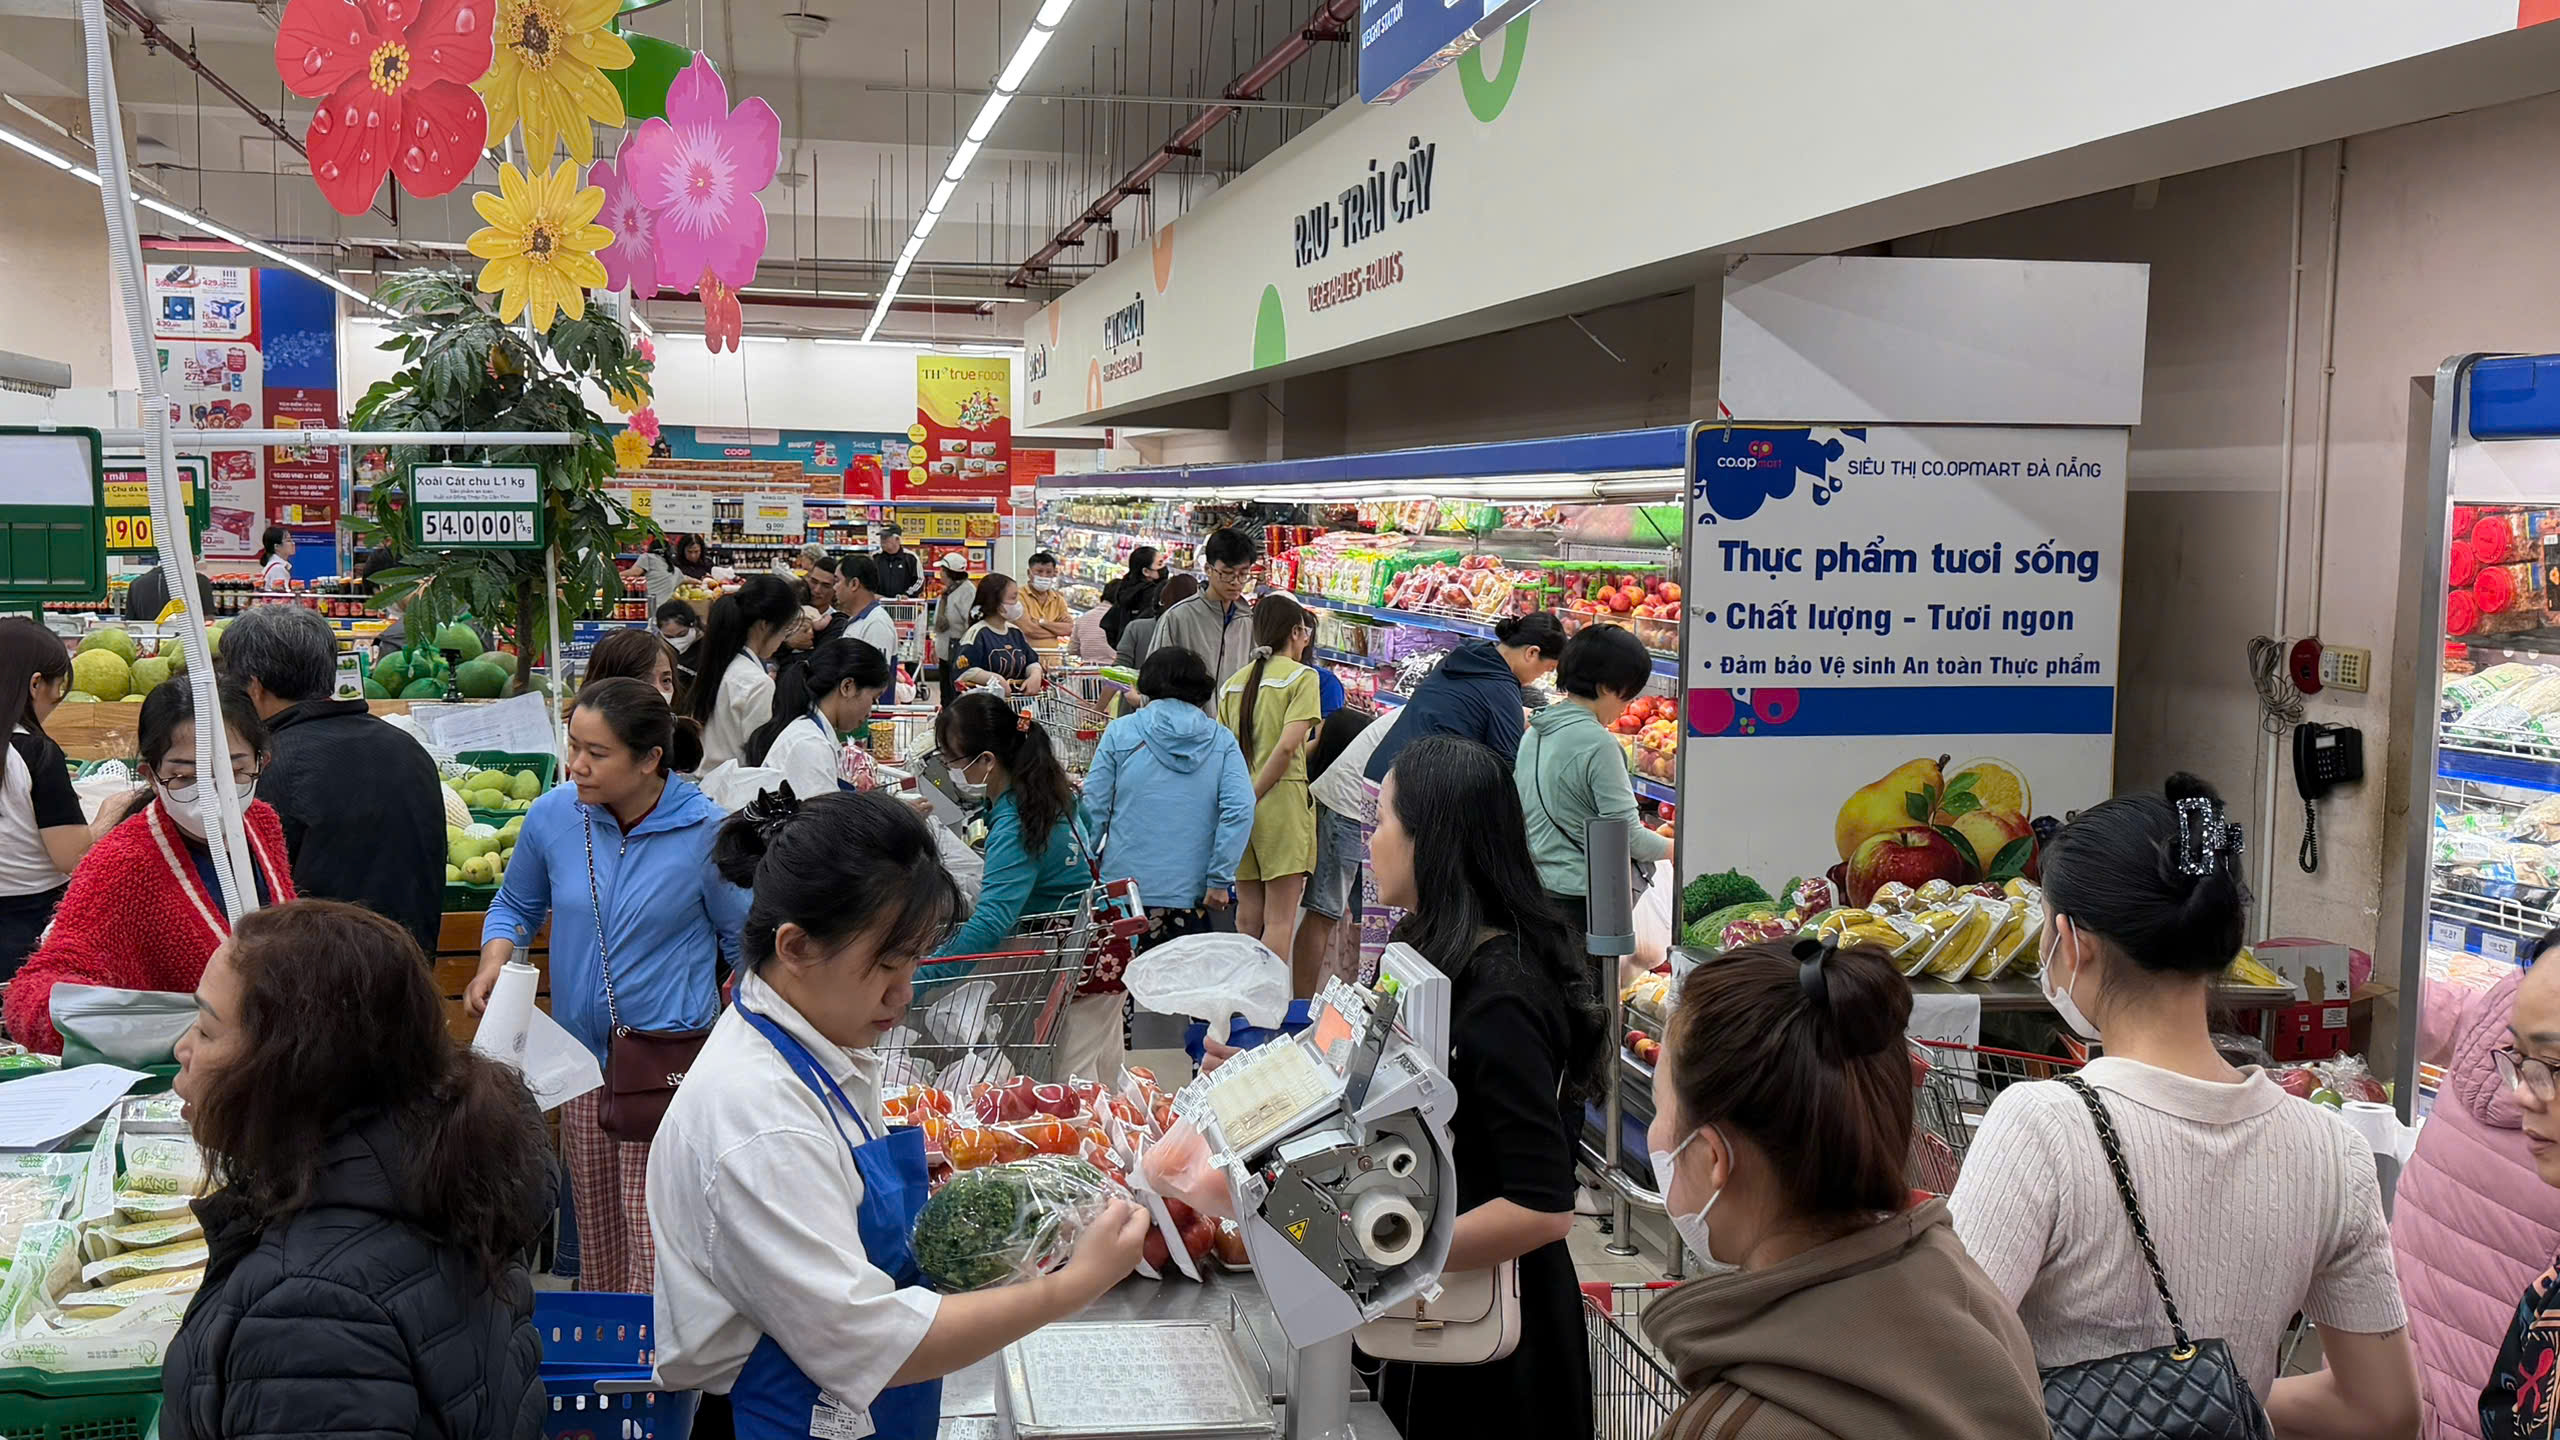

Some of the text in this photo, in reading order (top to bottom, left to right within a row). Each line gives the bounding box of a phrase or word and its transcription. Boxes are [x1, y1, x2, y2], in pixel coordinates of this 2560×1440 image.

[1362, 19, 1382, 50] WEIGHT
[1381, 1, 1404, 34] STATION
[1389, 136, 1436, 224] CÂY
[921, 368, 1005, 381] TH true FOOD
[1847, 456, 2102, 479] SIÊU THỊ CO.OPMART ĐÀ NẴNG
[416, 476, 525, 488] Xoài Cát chu L1 kg
[426, 514, 511, 535] 54.000
[1718, 535, 2100, 582] Thực phẩm tươi sống
[1726, 599, 1798, 631] Chất
[1808, 603, 1892, 637] lượng
[1927, 603, 1991, 631] Tươi
[2002, 608, 2074, 637] ngon
[1720, 652, 2101, 679] Đảm bảo Vệ sinh An toàn Thực phẩm
[131, 1175, 178, 1192] MĂNG
